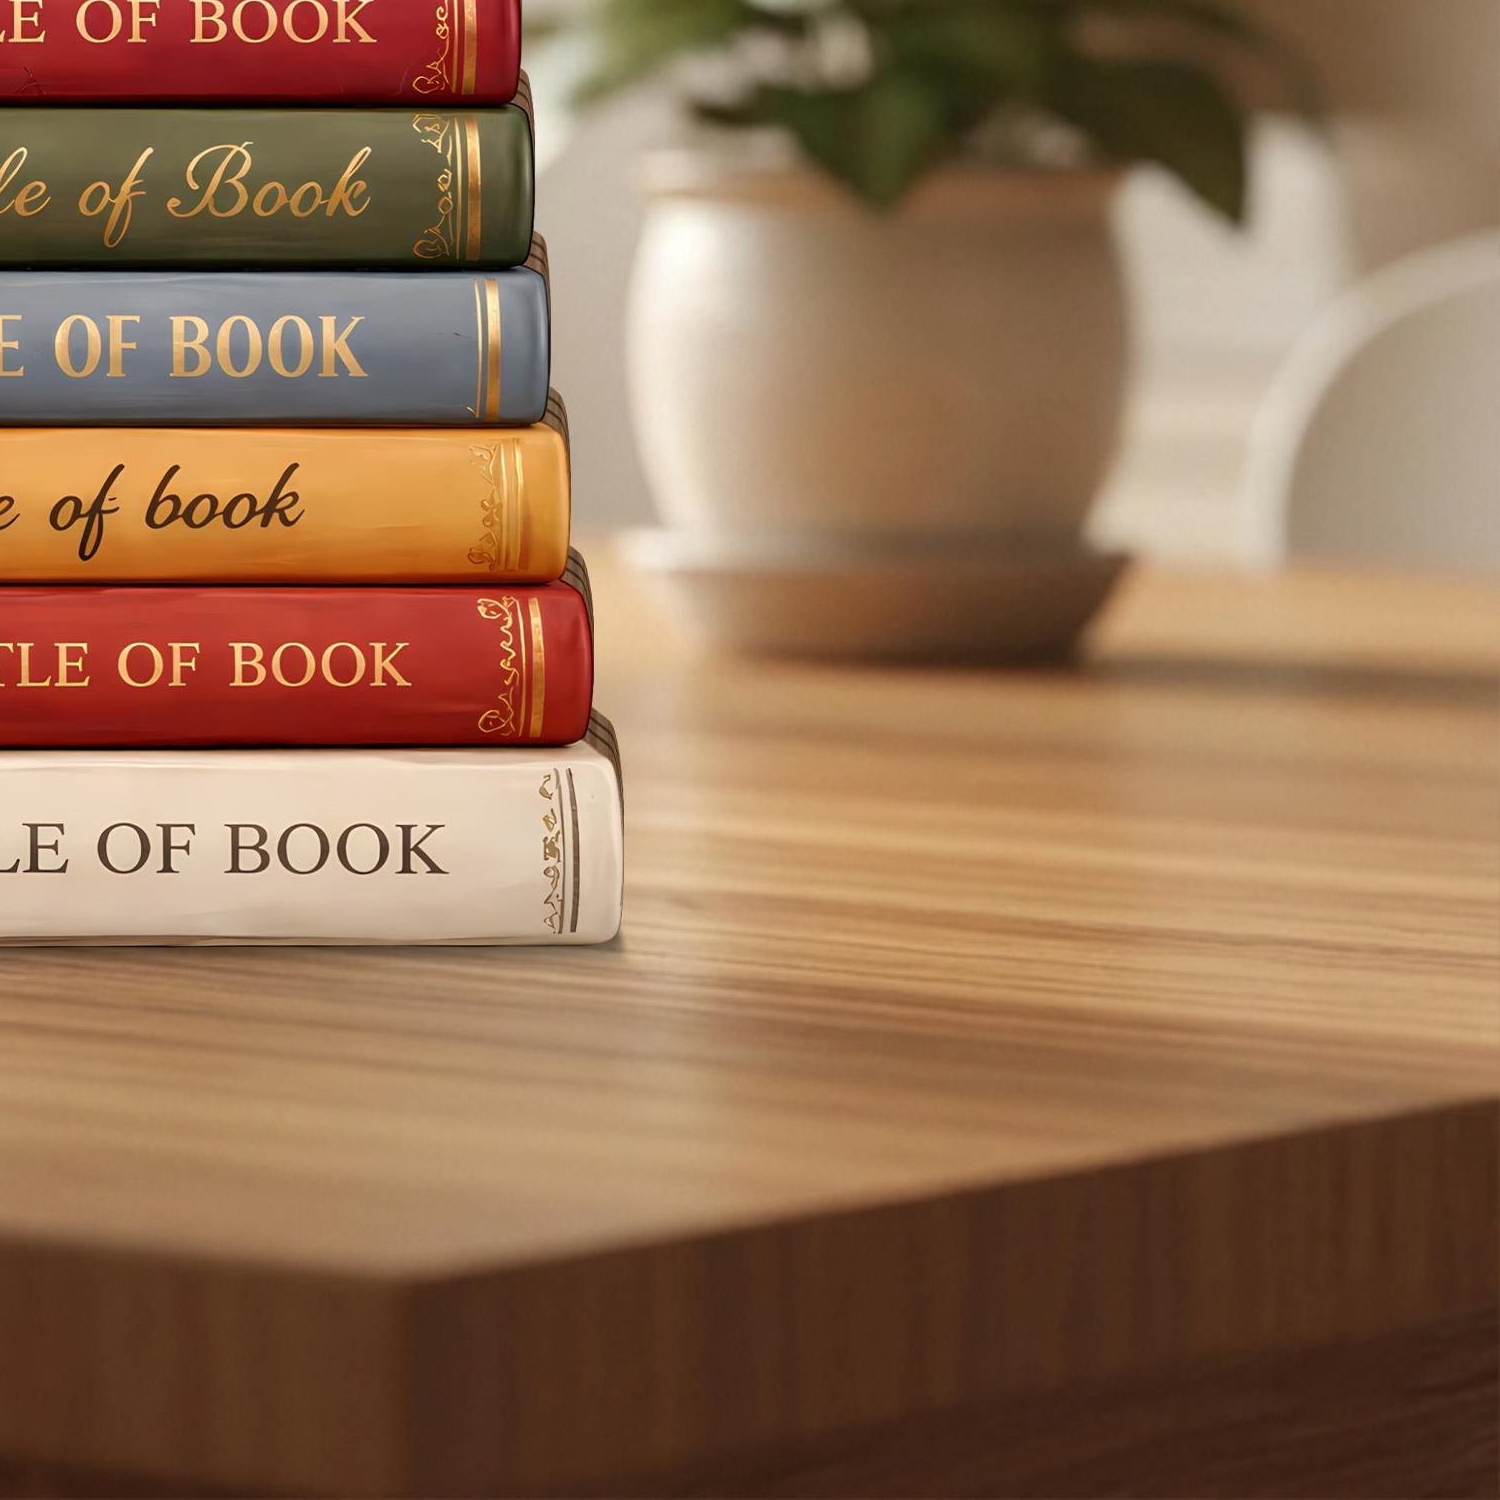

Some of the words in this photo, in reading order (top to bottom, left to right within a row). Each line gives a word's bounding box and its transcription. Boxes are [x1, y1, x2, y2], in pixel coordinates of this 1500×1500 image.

[189, 0, 377, 43] BOOK
[79, 147, 154, 245] of
[167, 141, 372, 217] Book
[55, 315, 140, 377] OF
[169, 315, 367, 377] BOOK
[50, 463, 124, 561] of
[145, 463, 305, 529] book
[118, 642, 200, 687] OF
[229, 642, 412, 686] BOOK
[97, 823, 195, 874] OF
[224, 824, 449, 875] BOOK
